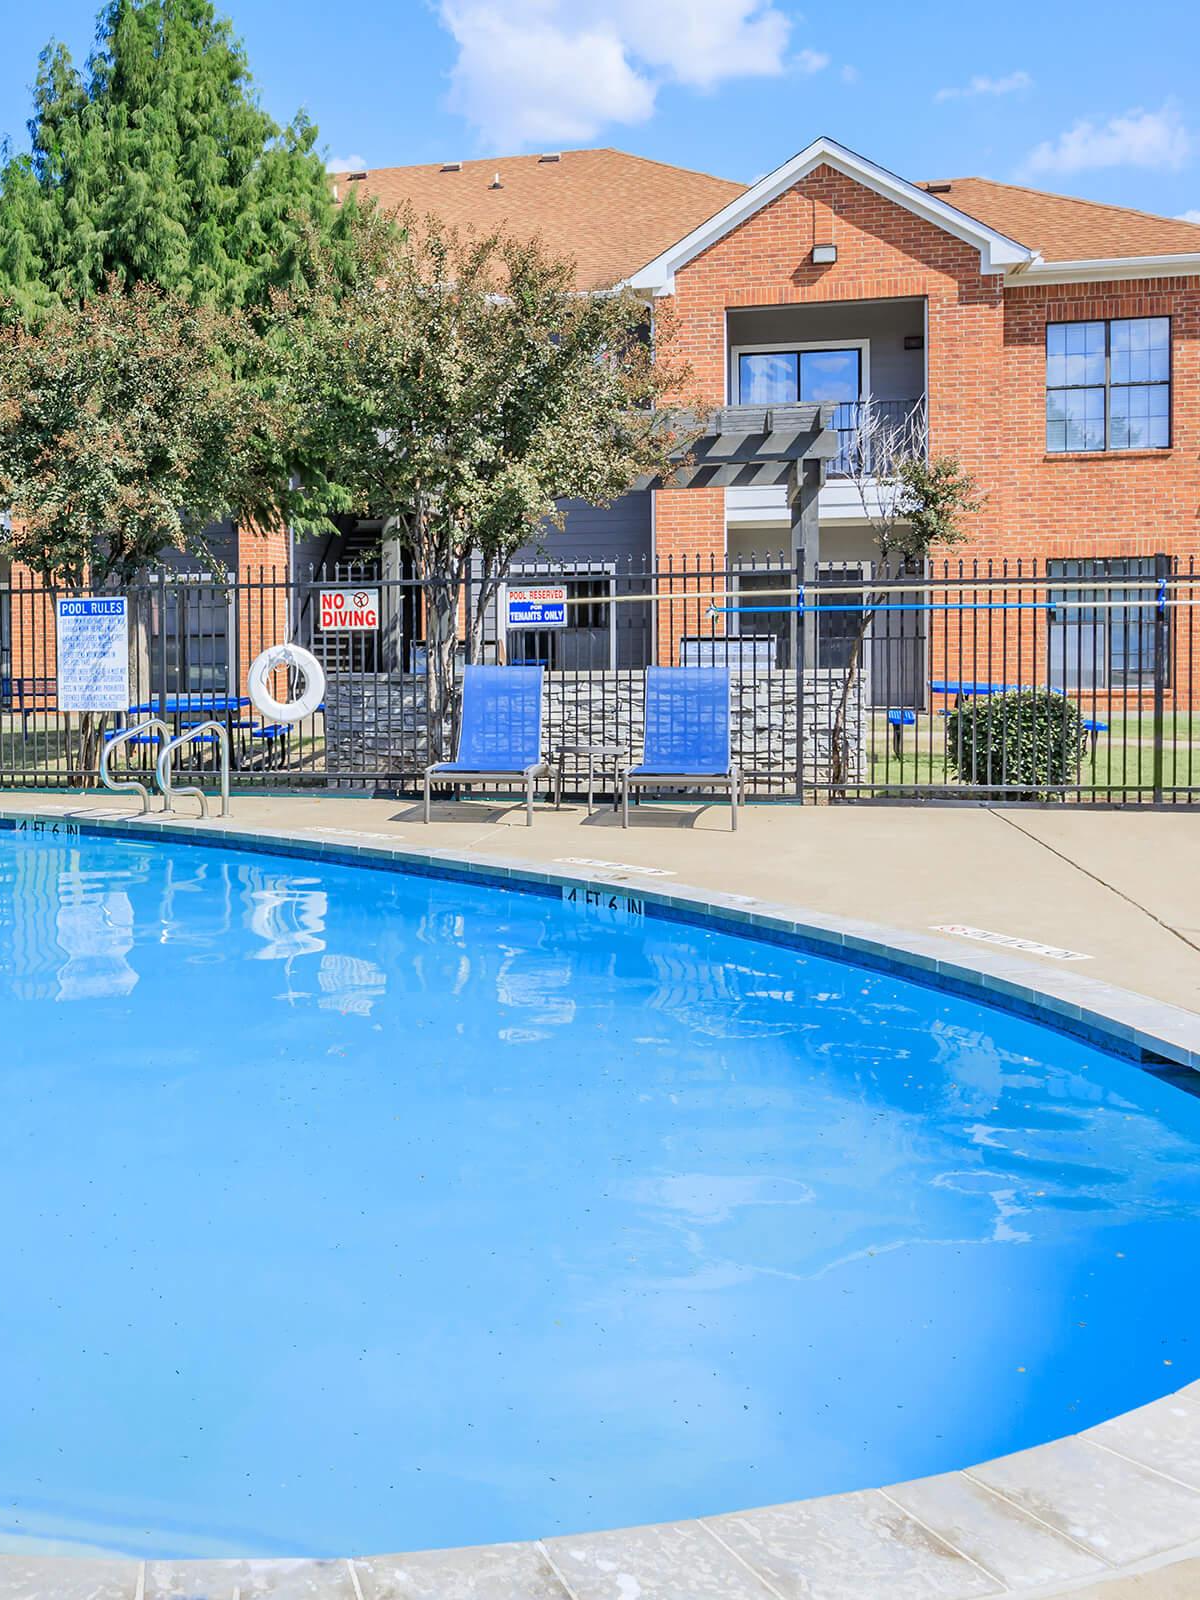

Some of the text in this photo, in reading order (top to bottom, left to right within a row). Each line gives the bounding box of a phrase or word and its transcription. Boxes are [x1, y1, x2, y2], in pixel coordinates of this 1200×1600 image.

[322, 593, 345, 609] NO
[509, 590, 563, 600] POOL RESERVED
[62, 602, 122, 614] POOL RULES
[322, 610, 376, 627] DIVING
[511, 610, 563, 621] TENANTS ONLY
[33, 821, 46, 832] FT
[52, 824, 60, 833] 6
[66, 824, 78, 835] IN
[586, 891, 600, 906] FT
[608, 896, 617, 910] 6
[627, 898, 641, 915] IN
